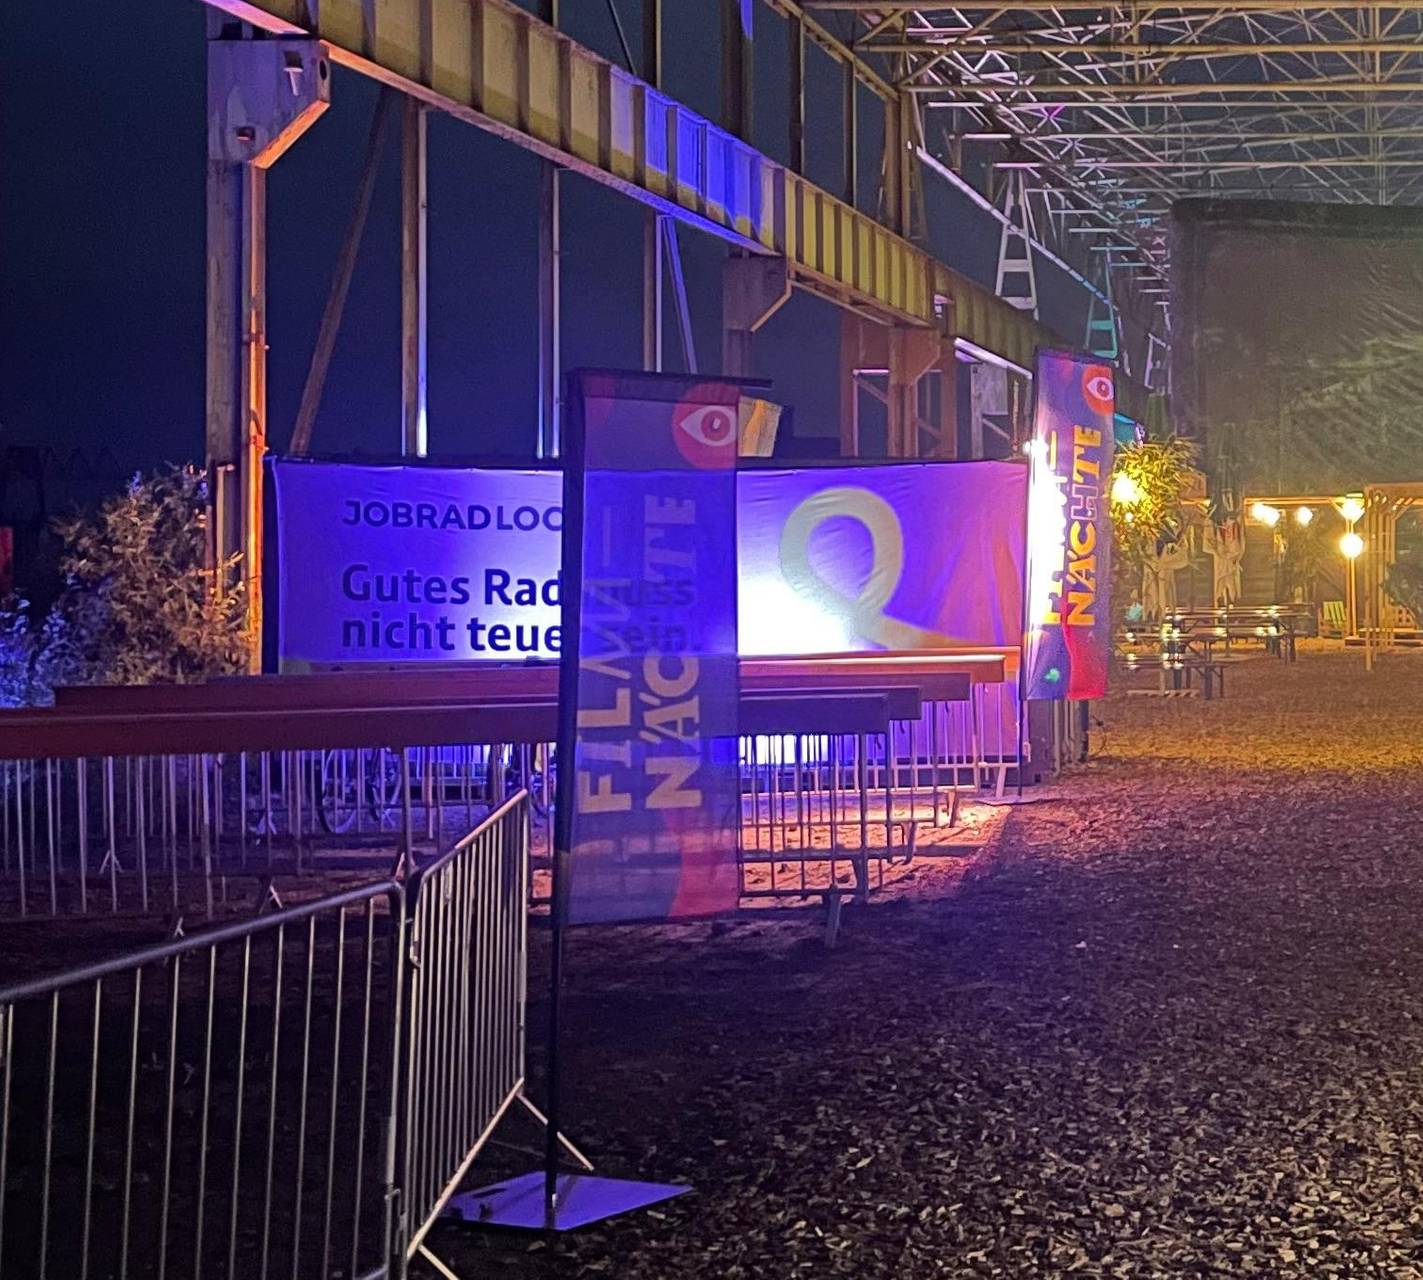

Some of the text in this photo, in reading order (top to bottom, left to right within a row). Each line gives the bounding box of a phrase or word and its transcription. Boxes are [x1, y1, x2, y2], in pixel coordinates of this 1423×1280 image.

[1066, 424, 1102, 627] NÄCHTE
[342, 564, 470, 605] Gutes
[484, 568, 563, 606] Rad
[342, 611, 455, 650] nicht
[466, 617, 563, 652] teue
